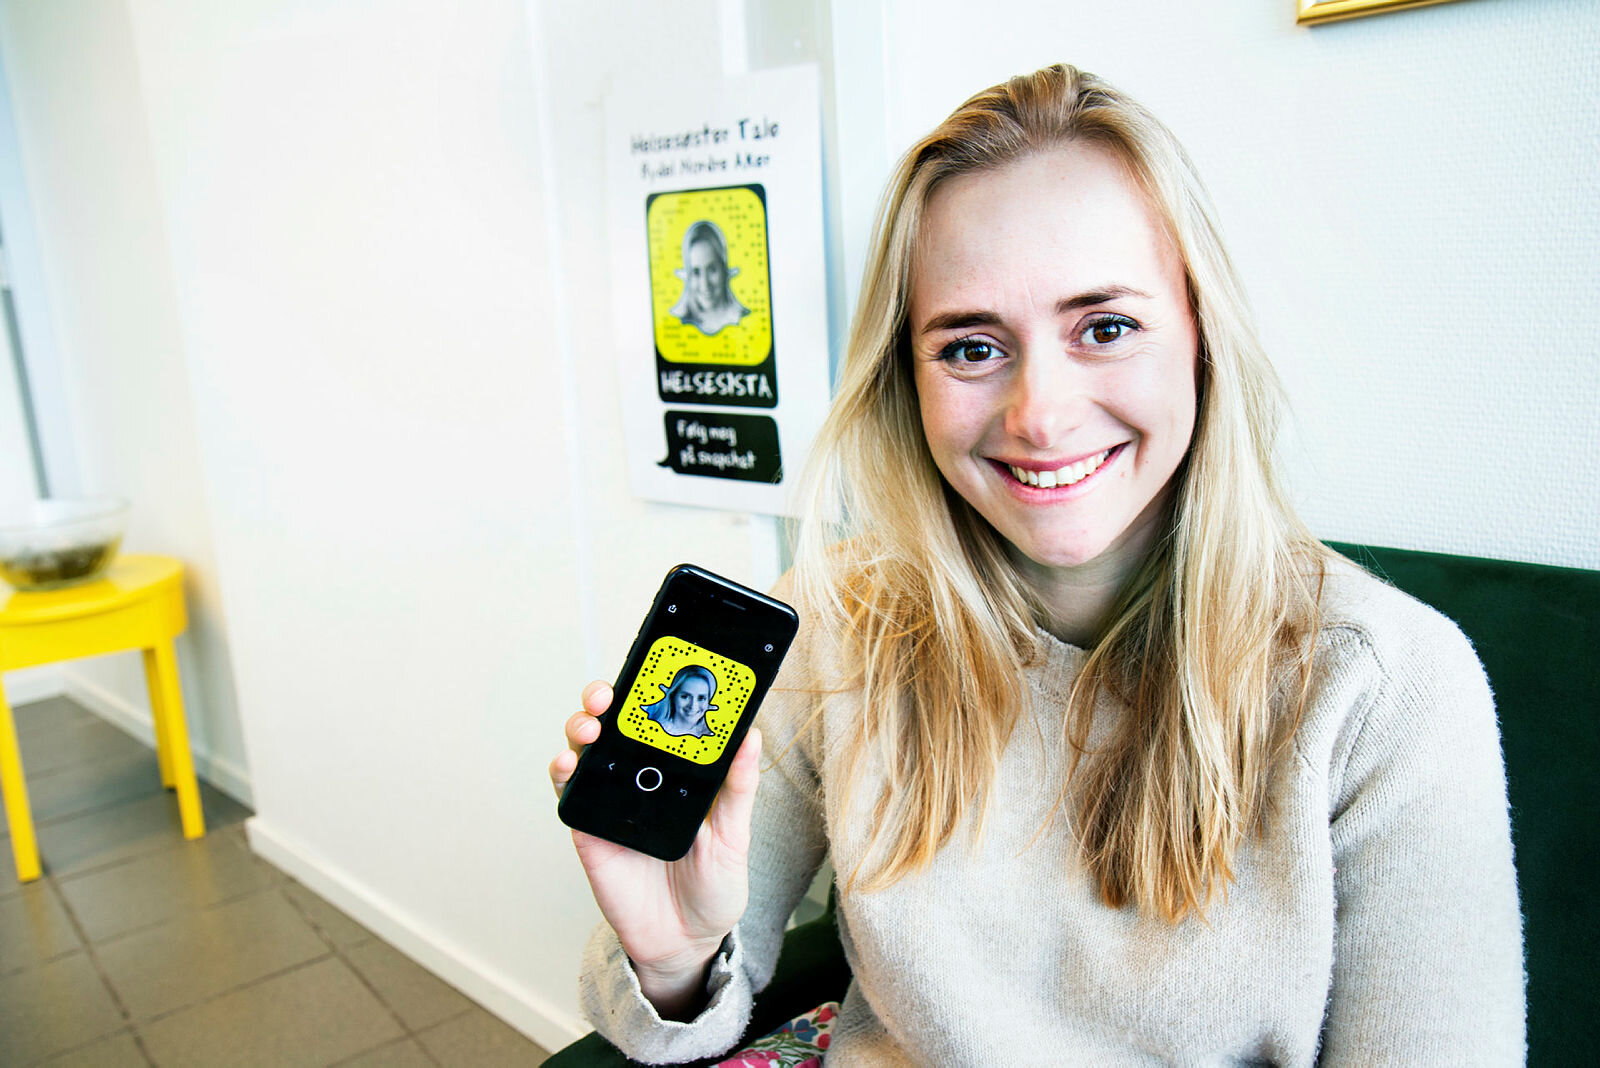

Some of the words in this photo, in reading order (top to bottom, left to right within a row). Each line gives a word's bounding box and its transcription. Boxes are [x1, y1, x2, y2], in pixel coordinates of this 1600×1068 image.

[738, 117, 779, 140] Tale
[661, 370, 773, 399] HELSESISTA
[708, 427, 736, 446] meg
[680, 444, 696, 467] på
